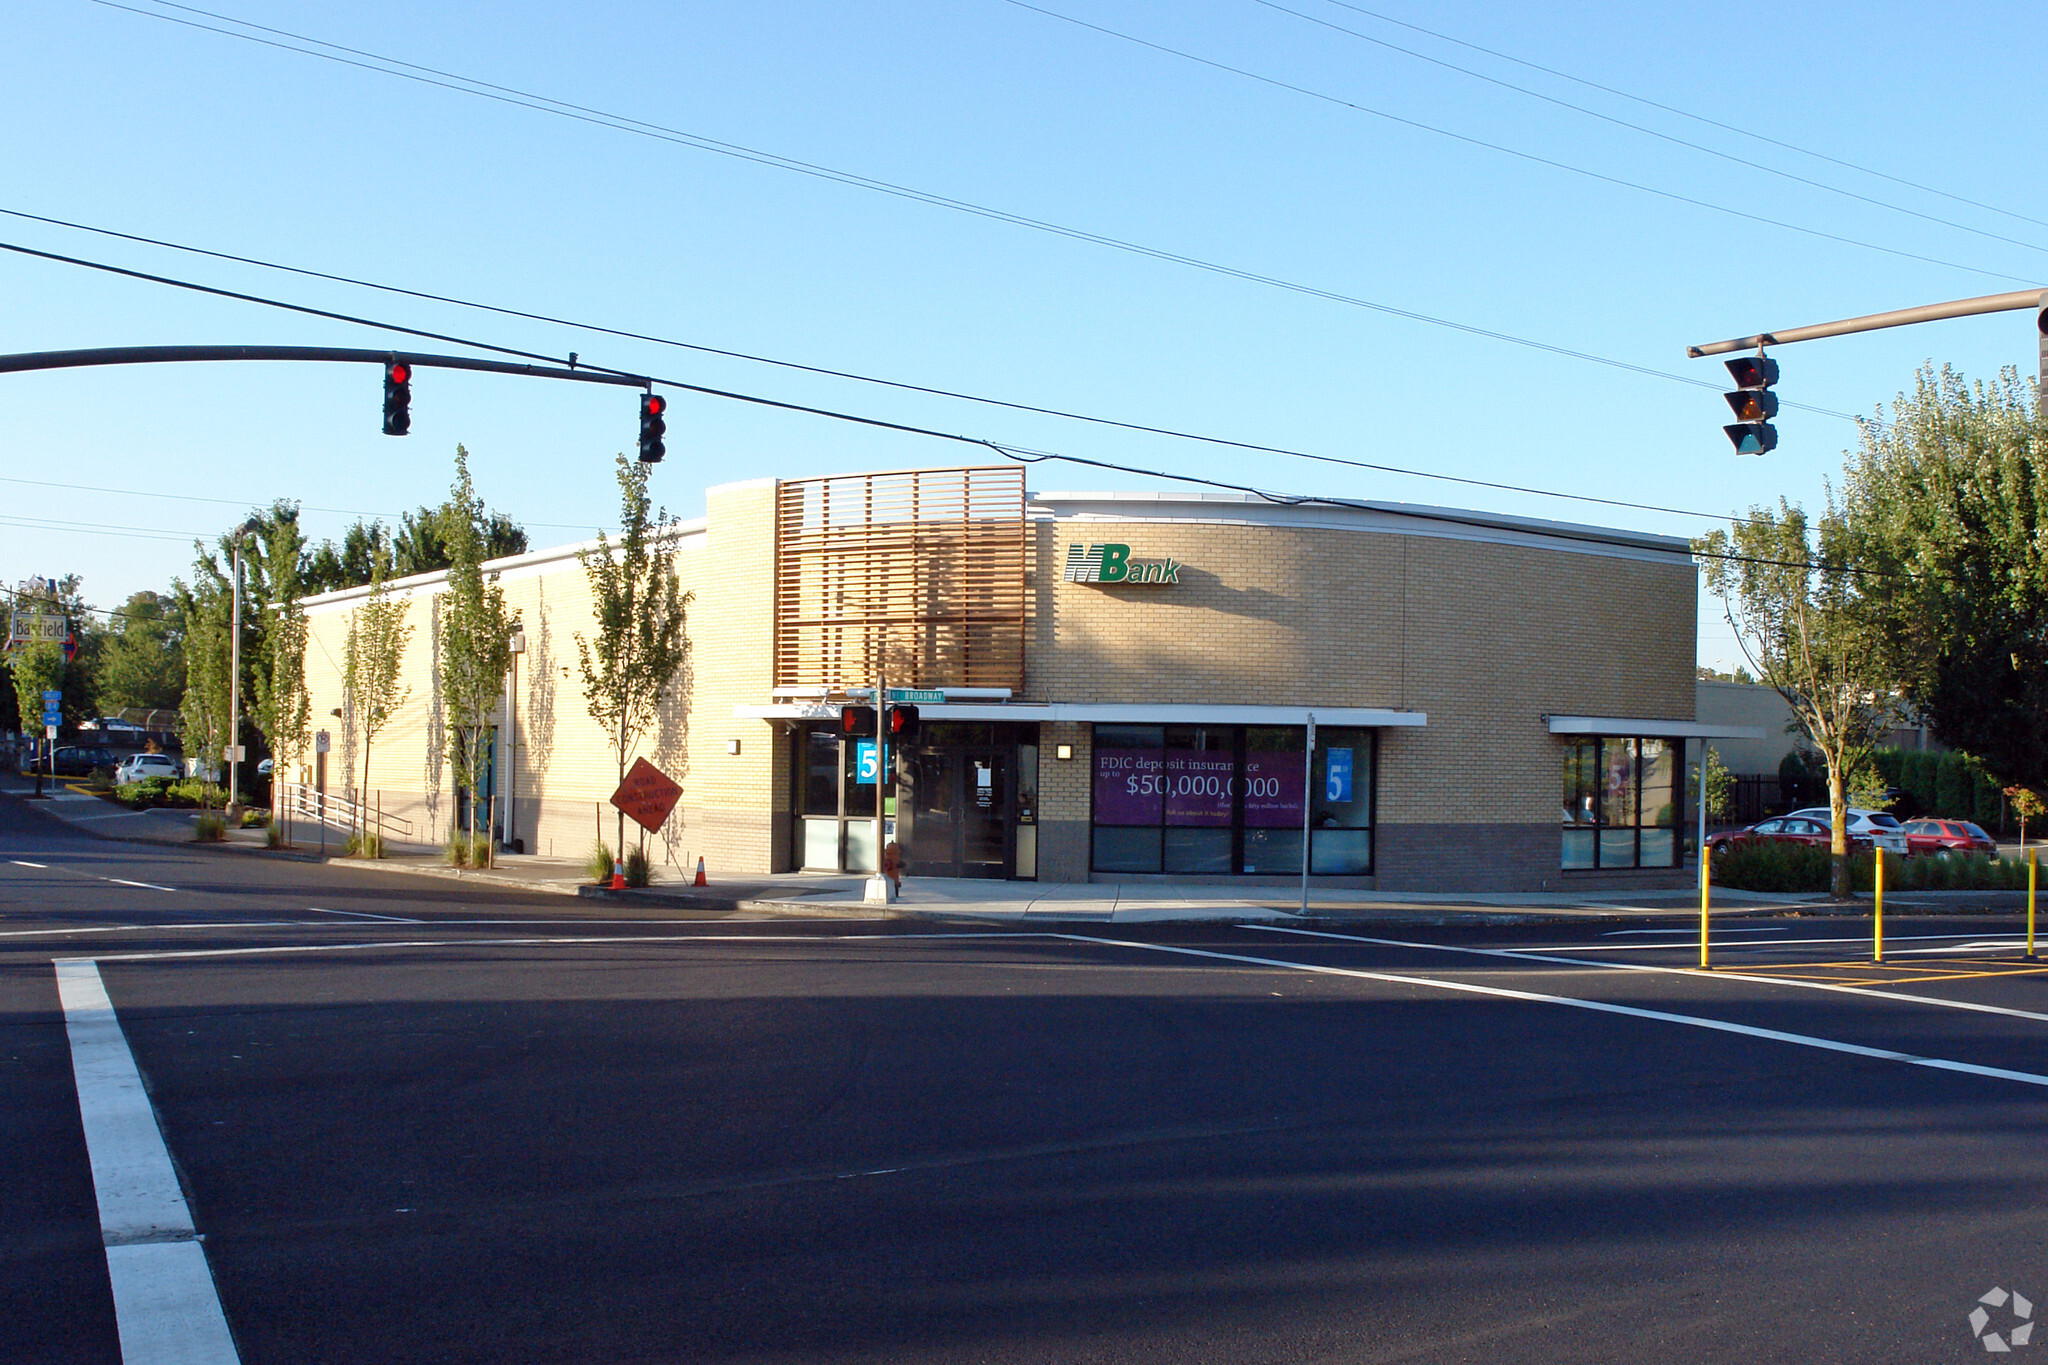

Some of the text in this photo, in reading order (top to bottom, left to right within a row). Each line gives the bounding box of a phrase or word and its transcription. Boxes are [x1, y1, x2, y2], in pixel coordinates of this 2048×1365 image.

[905, 691, 942, 700] BROADWAY
[1101, 757, 1133, 769] FDIC
[1136, 757, 1185, 772] deposit
[634, 775, 656, 787] ROAD
[1100, 771, 1111, 779] up
[1126, 774, 1279, 798] $50,000,000
[616, 787, 678, 804] CONSTRUCTION
[637, 802, 665, 815] AHEAD
